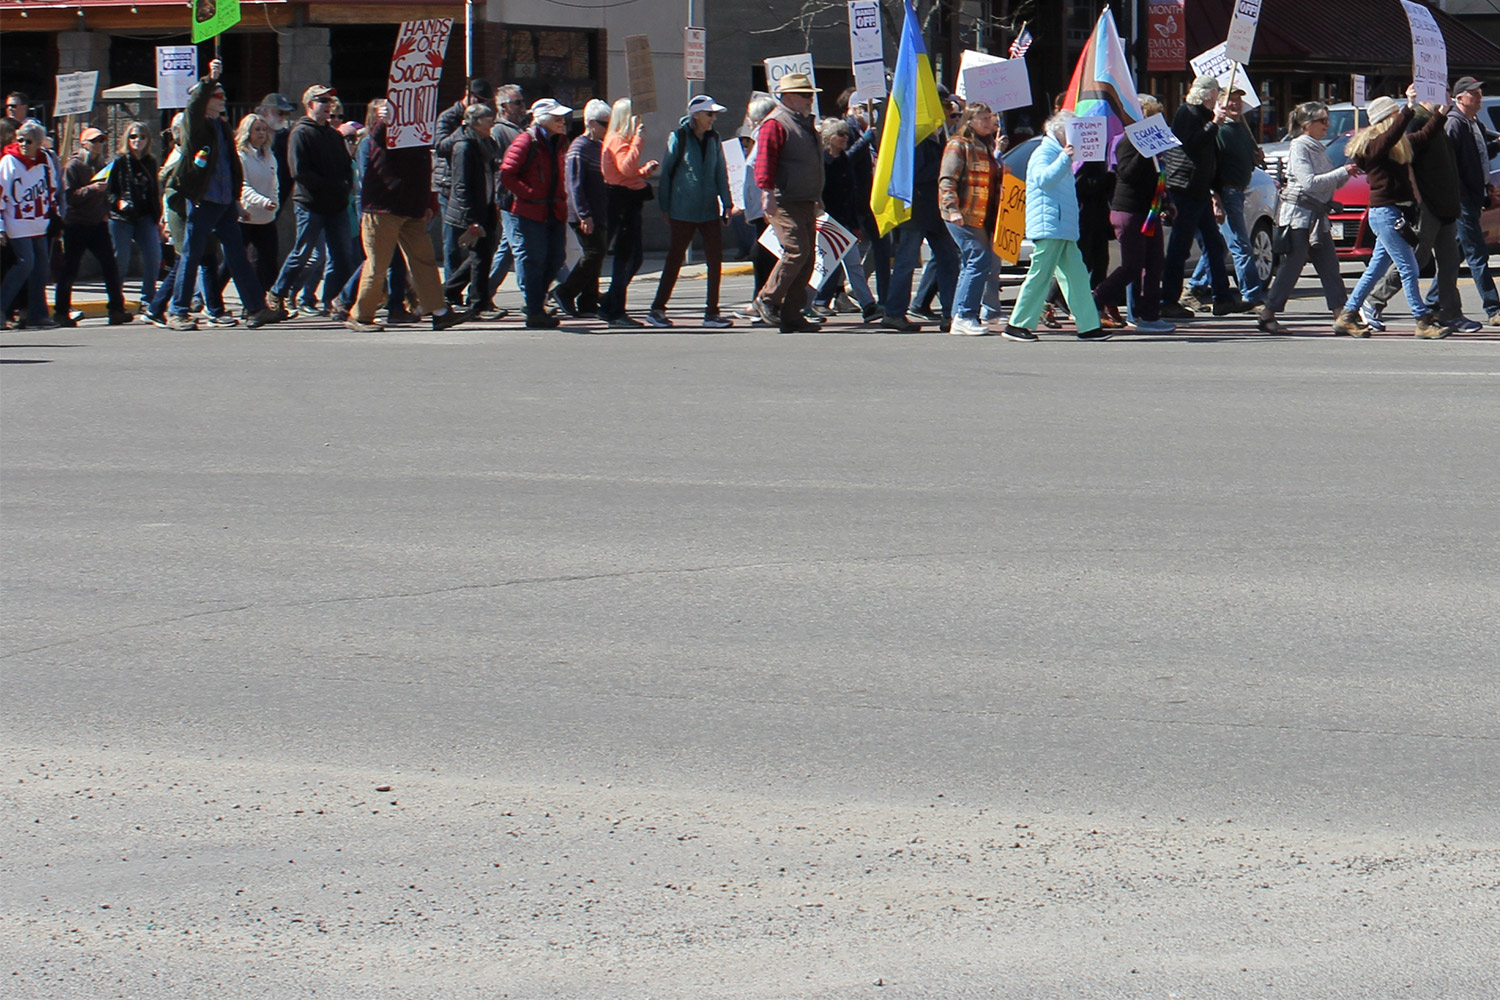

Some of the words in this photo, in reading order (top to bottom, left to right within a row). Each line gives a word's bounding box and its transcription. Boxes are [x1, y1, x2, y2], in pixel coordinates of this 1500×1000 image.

[1148, 5, 1184, 15] MONTH
[404, 18, 452, 36] HANDS
[416, 34, 446, 52] OFF
[1148, 38, 1185, 48] EMMA'S
[1149, 48, 1183, 58] HOUSE
[389, 56, 440, 83] SOCIAL
[771, 61, 811, 82] OMG
[980, 75, 1008, 89] BACK
[386, 84, 438, 127] SECURITY
[1071, 122, 1103, 131] TRUMP
[1133, 124, 1162, 141] EQUAL
